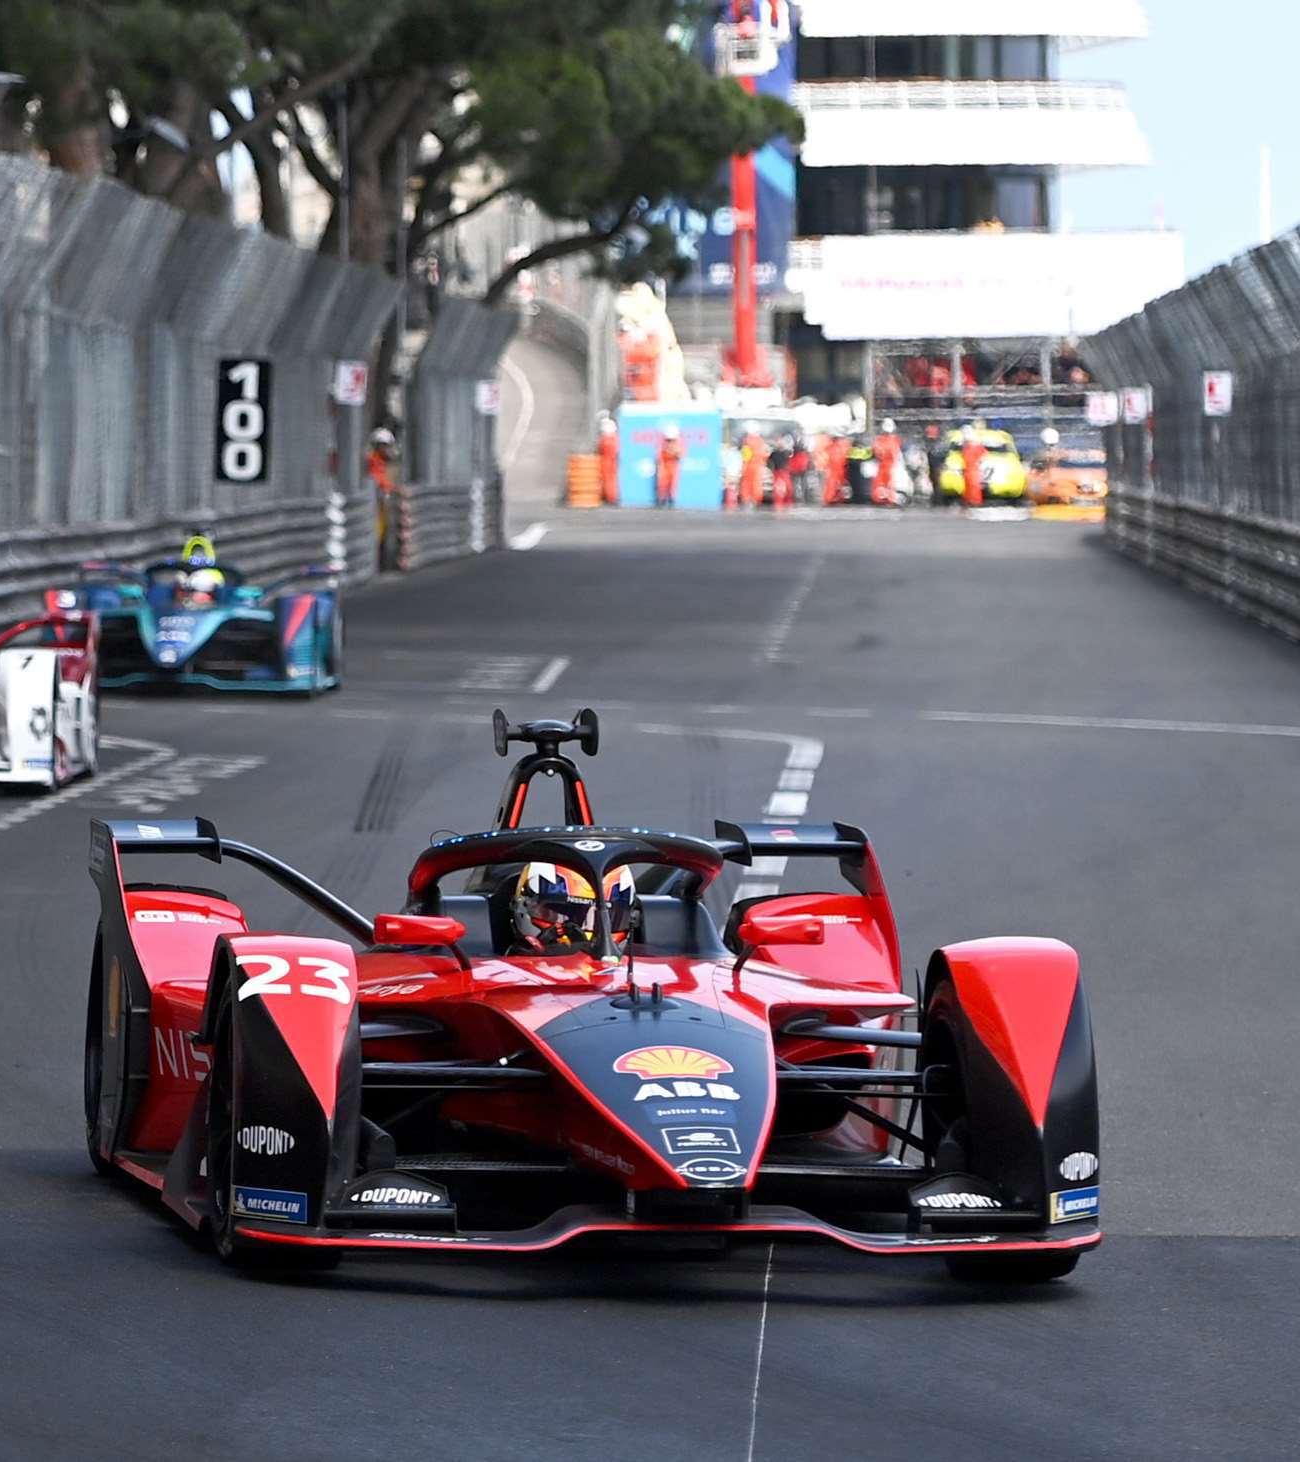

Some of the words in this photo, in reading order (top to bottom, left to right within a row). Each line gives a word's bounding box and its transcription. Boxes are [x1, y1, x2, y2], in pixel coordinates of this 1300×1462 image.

[222, 362, 263, 482] 100
[236, 955, 351, 1004] 23
[633, 1082, 740, 1101] ABB
[242, 1126, 289, 1155] DUPONT
[361, 1187, 432, 1204] DUPONT
[926, 1193, 994, 1208] DUPONT
[247, 1198, 300, 1213] MICHELIN
